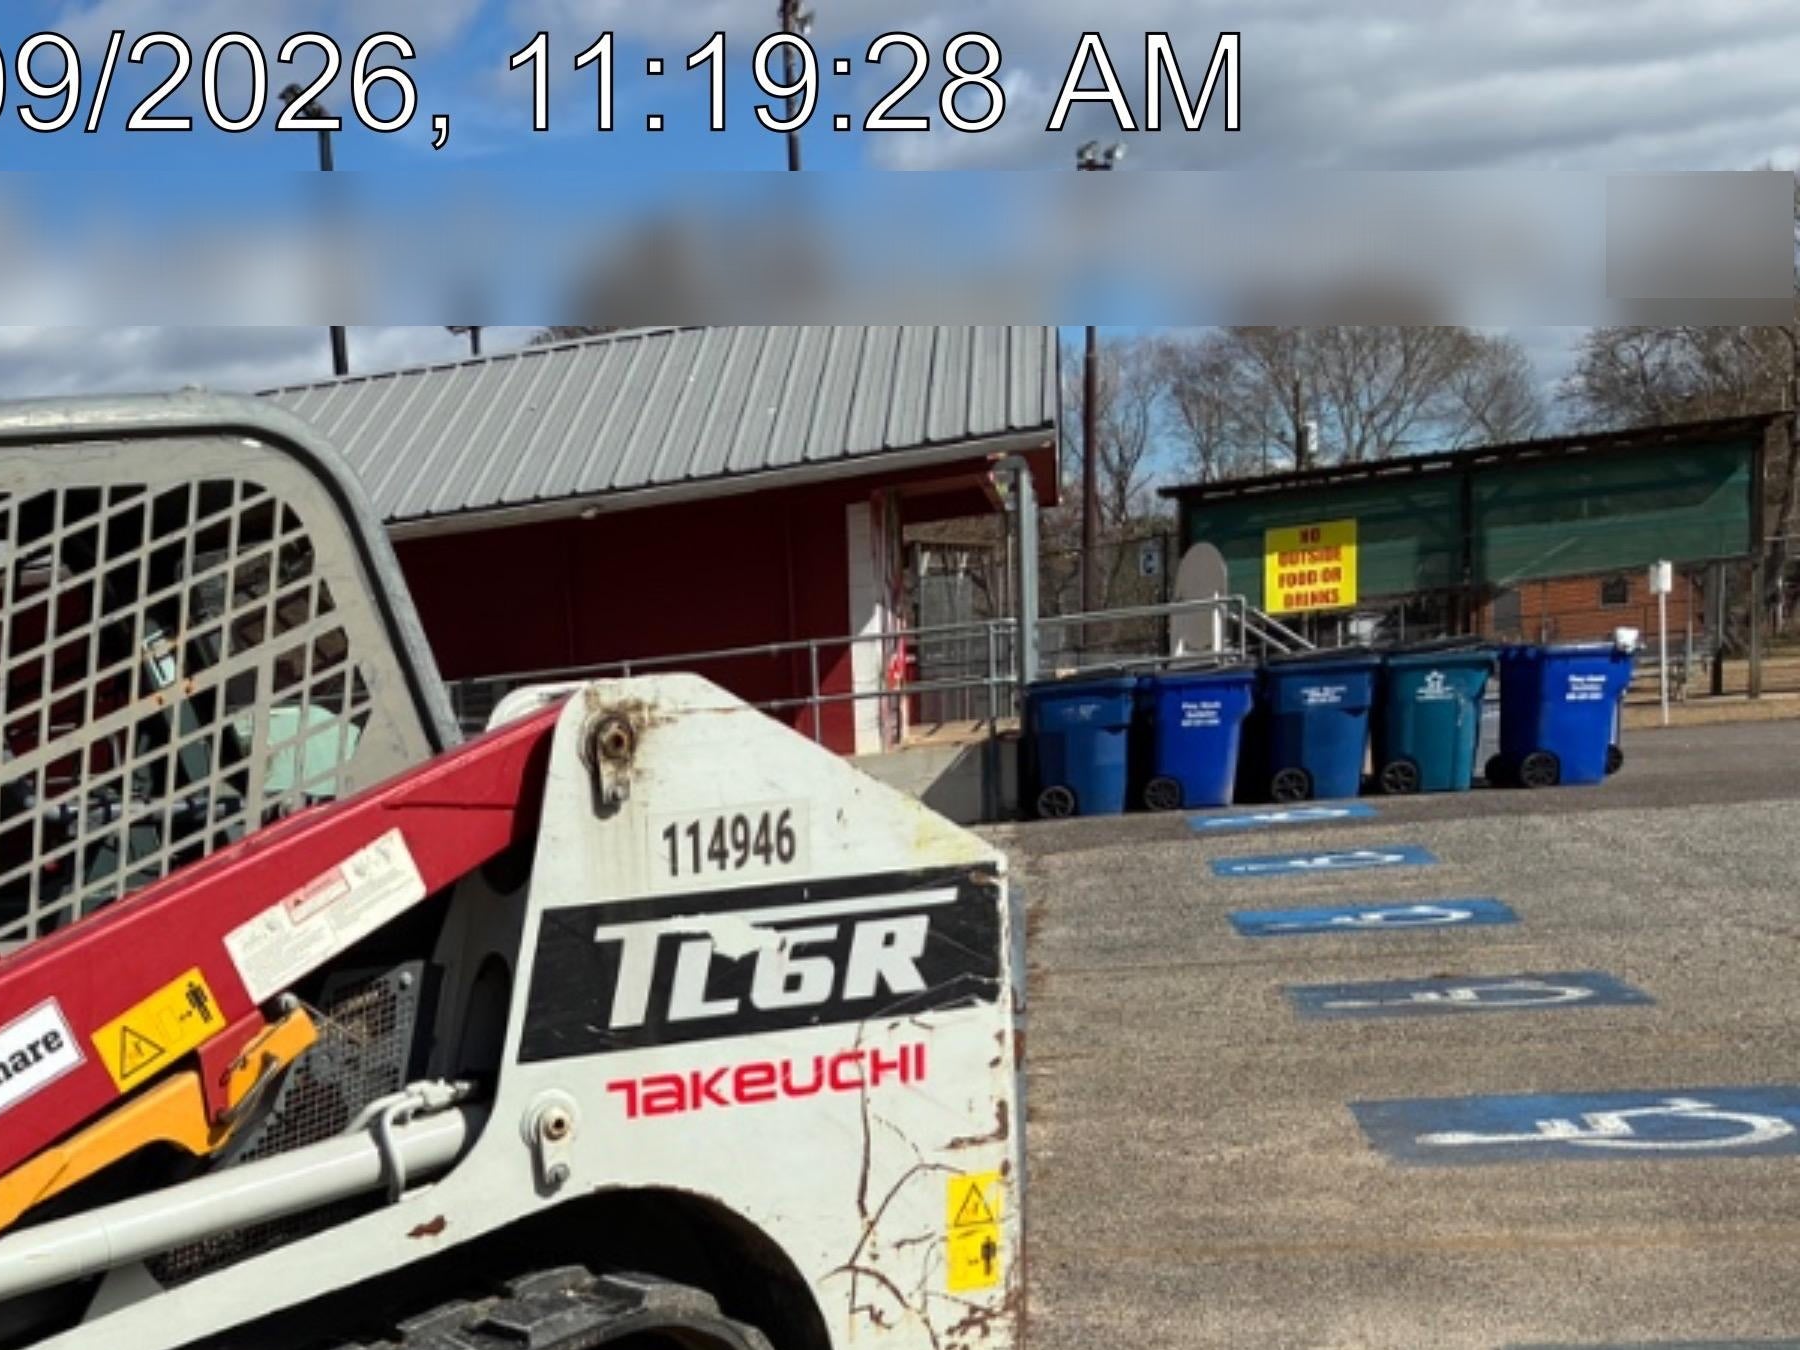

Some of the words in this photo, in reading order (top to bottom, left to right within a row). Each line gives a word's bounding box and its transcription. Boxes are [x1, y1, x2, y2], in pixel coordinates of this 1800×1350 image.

[1300, 527, 1320, 544] NO
[1278, 546, 1342, 568] OUTSIDE
[1278, 571, 1318, 588] FOOD
[1322, 567, 1342, 583] OR
[1283, 589, 1339, 609] DRINKS
[662, 807, 796, 877] 114946
[594, 910, 931, 1030] TL6R
